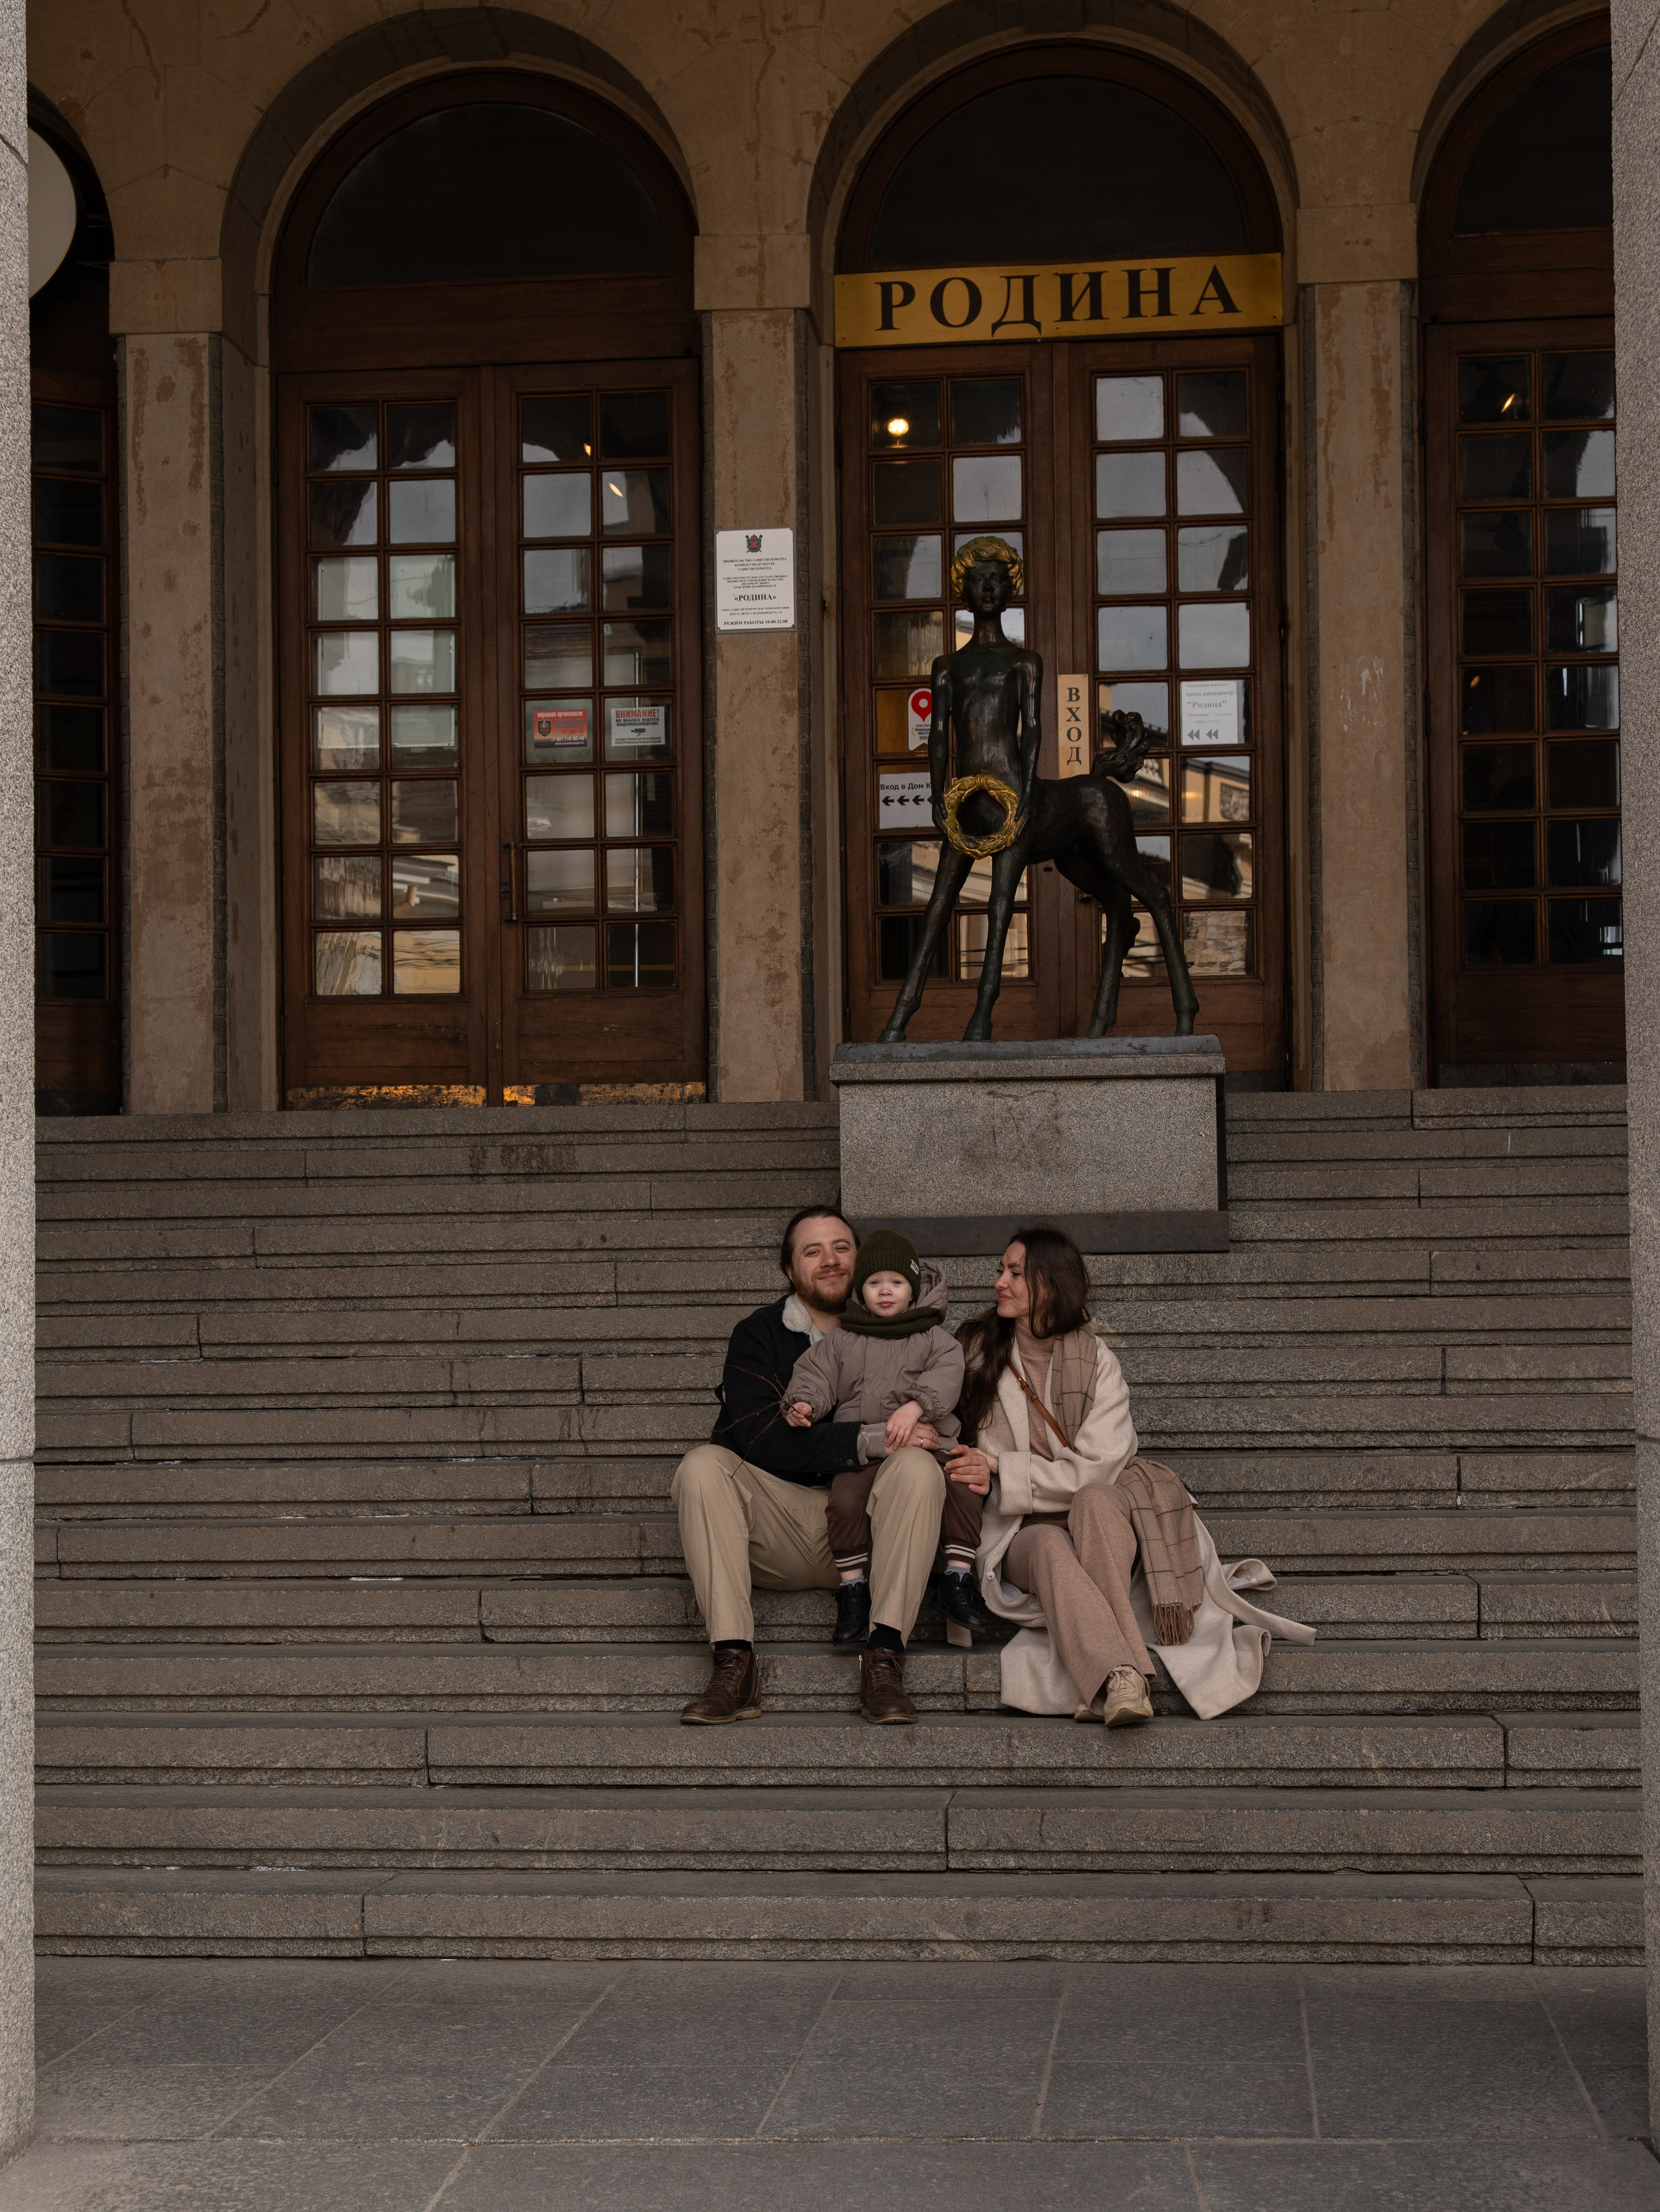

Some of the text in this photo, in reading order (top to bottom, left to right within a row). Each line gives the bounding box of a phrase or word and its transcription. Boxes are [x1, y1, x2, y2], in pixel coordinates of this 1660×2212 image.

[873, 264, 1242, 338] РОДИНА
[615, 708, 659, 719] ВНИМАНИЕ!
[1065, 687, 1082, 766] ВХОД
